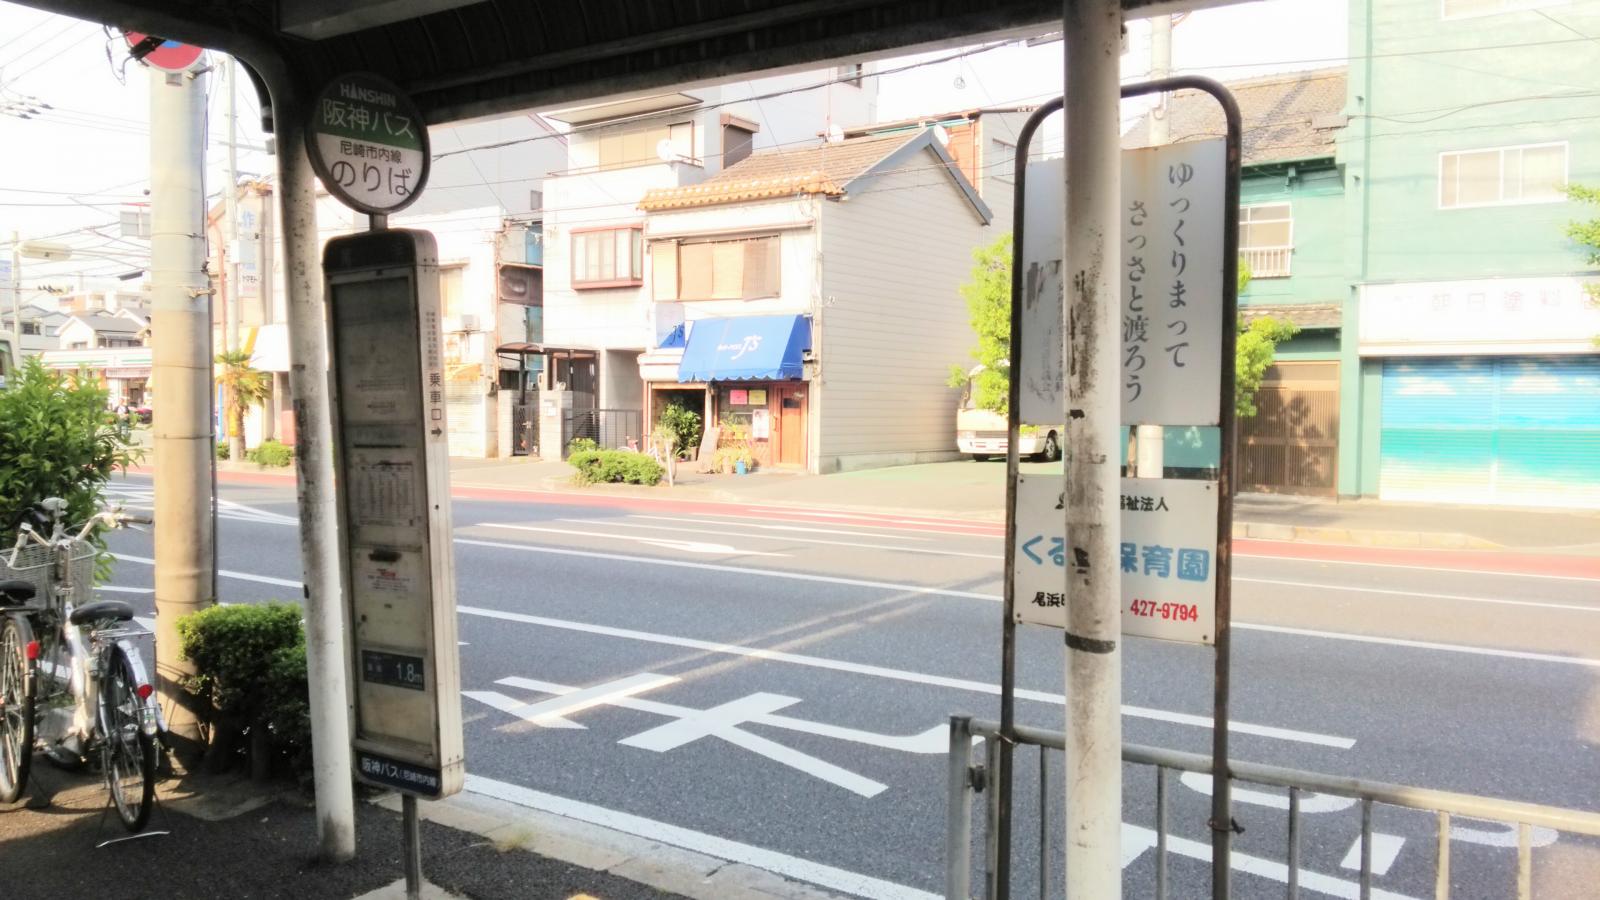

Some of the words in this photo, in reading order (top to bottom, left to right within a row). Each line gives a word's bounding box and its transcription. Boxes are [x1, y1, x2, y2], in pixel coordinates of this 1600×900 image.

[340, 83, 397, 107] HANSHIN
[322, 99, 414, 139] 阪神バス
[340, 140, 402, 164] 尼崎市内線
[331, 160, 413, 196] のりば
[1164, 162, 1193, 368] ゆっくりまって
[1123, 200, 1149, 402] さっさと渡ろう
[429, 372, 442, 421] 乗車口
[1032, 591, 1064, 608] 尾浜
[1129, 598, 1199, 622] 427-9794
[396, 662, 423, 684] 1.8m
